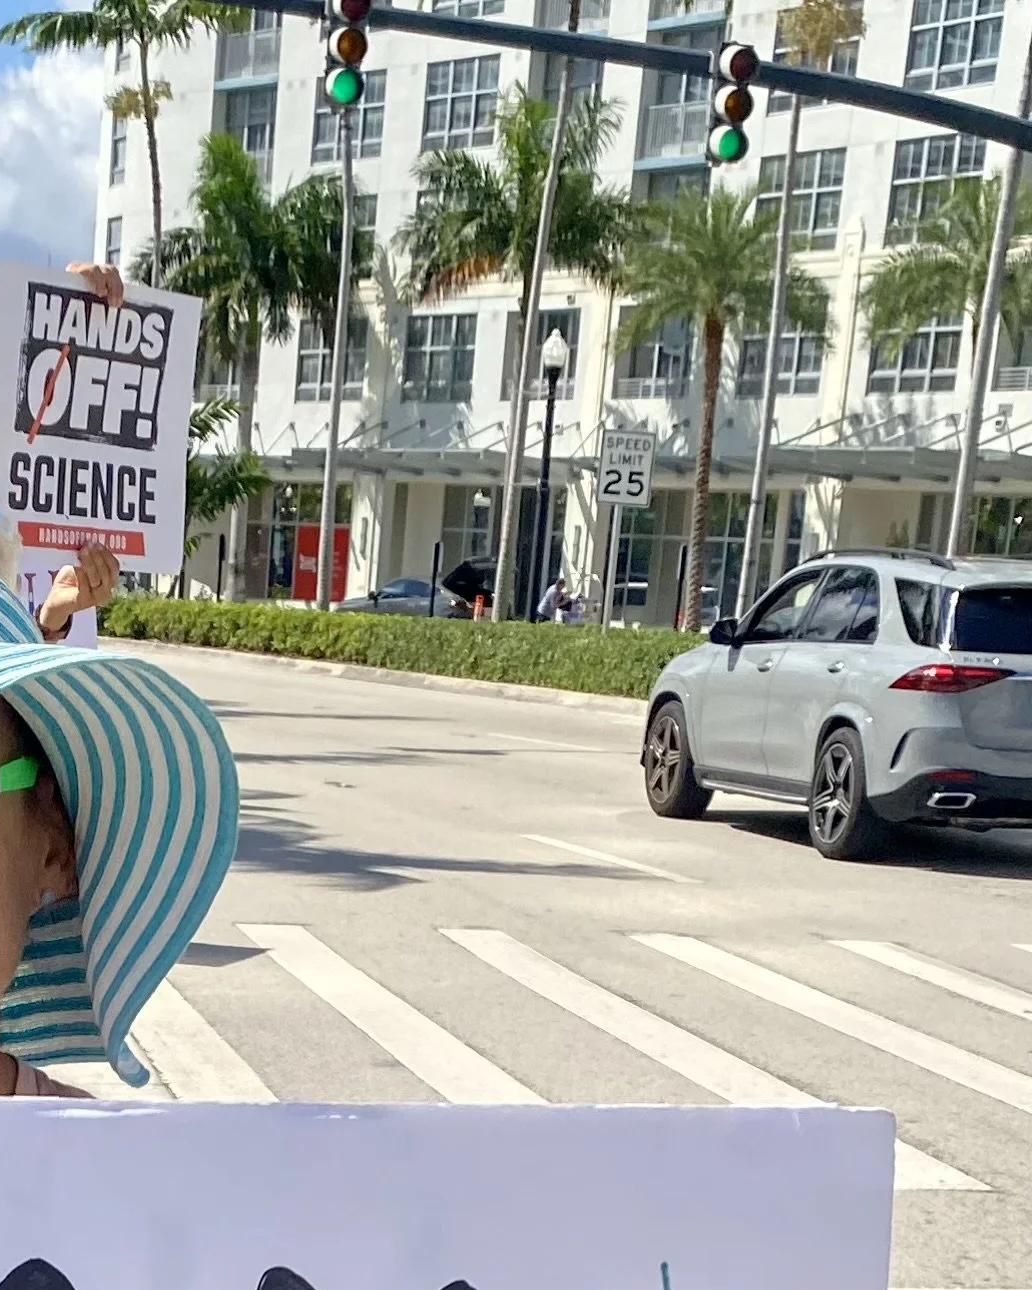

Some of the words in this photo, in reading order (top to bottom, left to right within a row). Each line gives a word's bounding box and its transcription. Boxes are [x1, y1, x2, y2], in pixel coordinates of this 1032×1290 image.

[32, 291, 165, 360] HANDS
[27, 347, 160, 439] OFF!
[607, 436, 651, 451] SPEED
[609, 452, 644, 466] LIMIT
[8, 452, 157, 524] SCIENCE
[604, 469, 644, 496] 25
